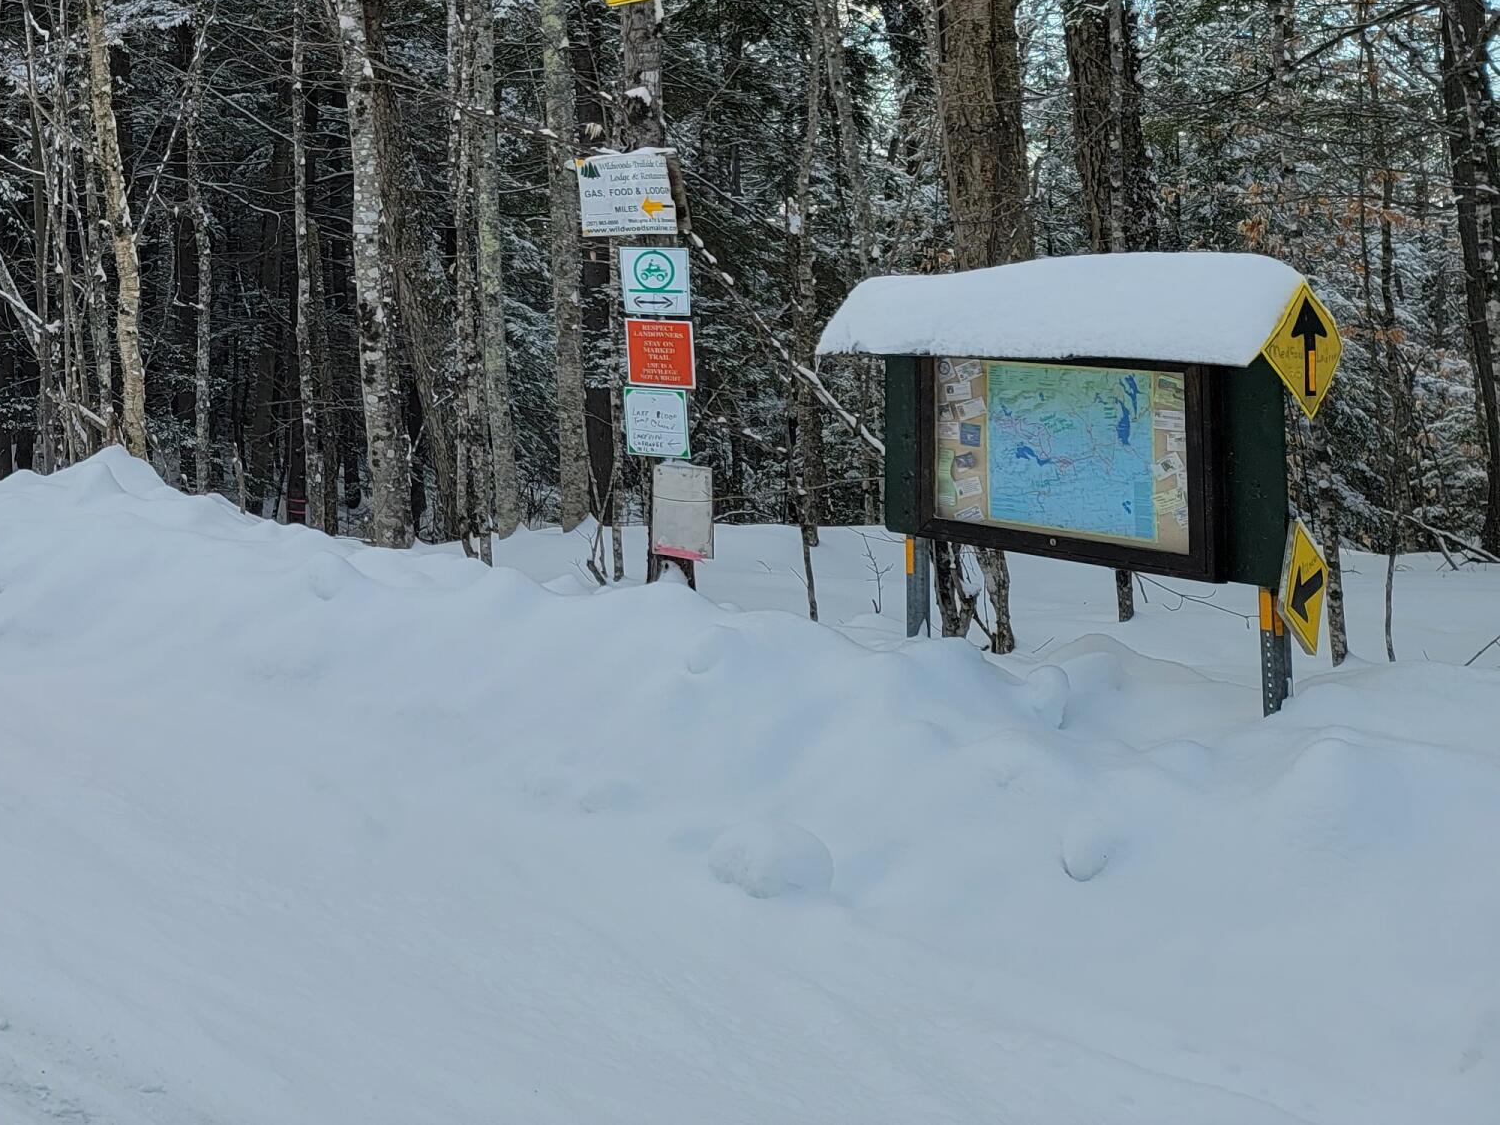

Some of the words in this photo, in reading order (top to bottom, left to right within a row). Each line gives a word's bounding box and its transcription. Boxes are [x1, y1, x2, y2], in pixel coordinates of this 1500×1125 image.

[584, 190, 605, 198] GAS,
[609, 188, 633, 197] FOOD
[635, 187, 641, 195] &
[614, 205, 639, 213] MILES
[587, 225, 677, 233] www.wildwoodsmaine.co
[633, 331, 684, 339] LANDOWNERS
